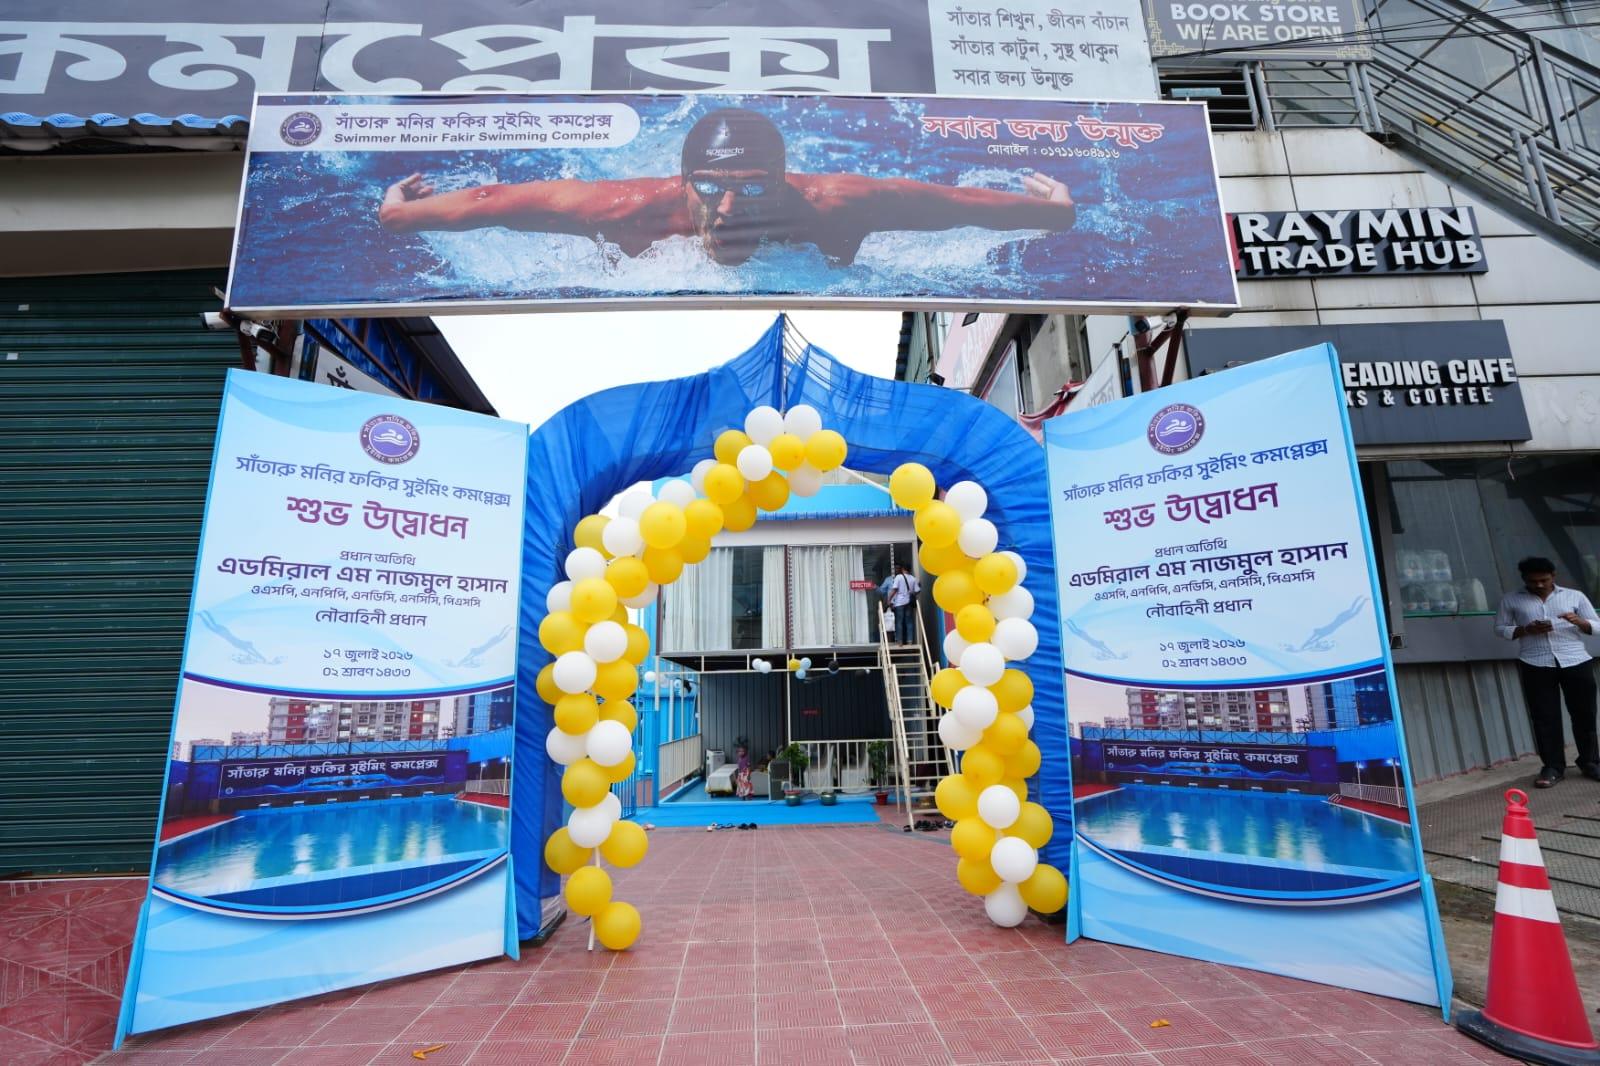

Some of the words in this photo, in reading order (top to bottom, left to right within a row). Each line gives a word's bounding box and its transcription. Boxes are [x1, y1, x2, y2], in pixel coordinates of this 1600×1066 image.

[946, 6, 991, 27] সাঁতার
[1046, 8, 1085, 29] জীবন
[1089, 11, 1129, 31] বাঁচান
[1170, 3, 1250, 21] BOOK
[1260, 5, 1340, 23] STORE
[1176, 23, 1216, 40] WE
[1222, 24, 1270, 41] ARE
[949, 34, 995, 56] সাঁতার
[1050, 43, 1077, 61] সুস্থ
[1079, 42, 1118, 64] থাকুন
[952, 69, 991, 85] সবার
[994, 71, 1026, 87] জন্য
[1030, 66, 1073, 90] উন্মুক্ত
[335, 112, 391, 129] সাঁতারু
[395, 113, 436, 129] মনির
[441, 112, 488, 128] ফকির
[492, 111, 542, 131] সুইমিং
[547, 114, 613, 128] কমপ্লেক্স
[334, 133, 396, 143] Swimmer
[400, 134, 438, 143] Monir
[442, 132, 475, 142] Fakir
[479, 132, 547, 142] Swimming
[552, 131, 609, 142] Complex
[920, 116, 1001, 140] সবার
[1005, 118, 1072, 142] জন্য
[1075, 115, 1165, 149] উন্মুক্ত
[1238, 206, 1474, 244] RAYMIN
[1242, 242, 1378, 270] TRADE
[1390, 239, 1483, 267] HUB
[1341, 360, 1441, 387] EADING
[1447, 358, 1517, 384] CAFE
[1383, 389, 1396, 405] &
[1408, 386, 1494, 404] COFFEE
[1063, 483, 1105, 501] সাঁতারু
[1107, 473, 1143, 492] মনির
[1146, 464, 1193, 484] ফকির
[1196, 452, 1247, 480] সুইমিং
[1250, 439, 1328, 464] কমপ্লেক্স
[236, 454, 297, 477] সাঁতারু
[300, 463, 346, 484] মনির
[349, 470, 400, 491] ফকির
[402, 477, 449, 498] সুইমিং
[452, 486, 511, 507] কমপ্লেক্স
[1103, 503, 1156, 531] শুভ
[1164, 482, 1278, 524] উদ্বোধন
[287, 496, 352, 526] শুভ
[362, 500, 469, 539] উদ্বোধন
[1155, 545, 1184, 558] প্রধান
[1185, 537, 1227, 552] অতিথি
[340, 550, 373, 562] প্রধান
[374, 552, 416, 566] অতিথি
[1069, 565, 1150, 587] এডমিরাল
[1156, 561, 1186, 577] এম
[1190, 550, 1273, 575] নাজমুল
[1278, 542, 1348, 566] হাসান
[217, 555, 332, 580] এডমিরাল
[337, 567, 372, 583] এম
[376, 569, 453, 595] নাজমুল
[456, 576, 508, 593] হাসান
[1266, 569, 1315, 584] পিএসসি
[443, 594, 481, 607] পিএসসি
[1146, 598, 1209, 618] নৌবাহিনী
[1213, 599, 1253, 613] প্রধান
[315, 607, 387, 625] নৌবাহিনী
[389, 614, 427, 626] প্রধান
[344, 648, 379, 663] জুলাই
[1177, 638, 1210, 654] জুলাই
[341, 667, 374, 677] শ্রাবণ
[1178, 657, 1208, 667] শ্রাবণ
